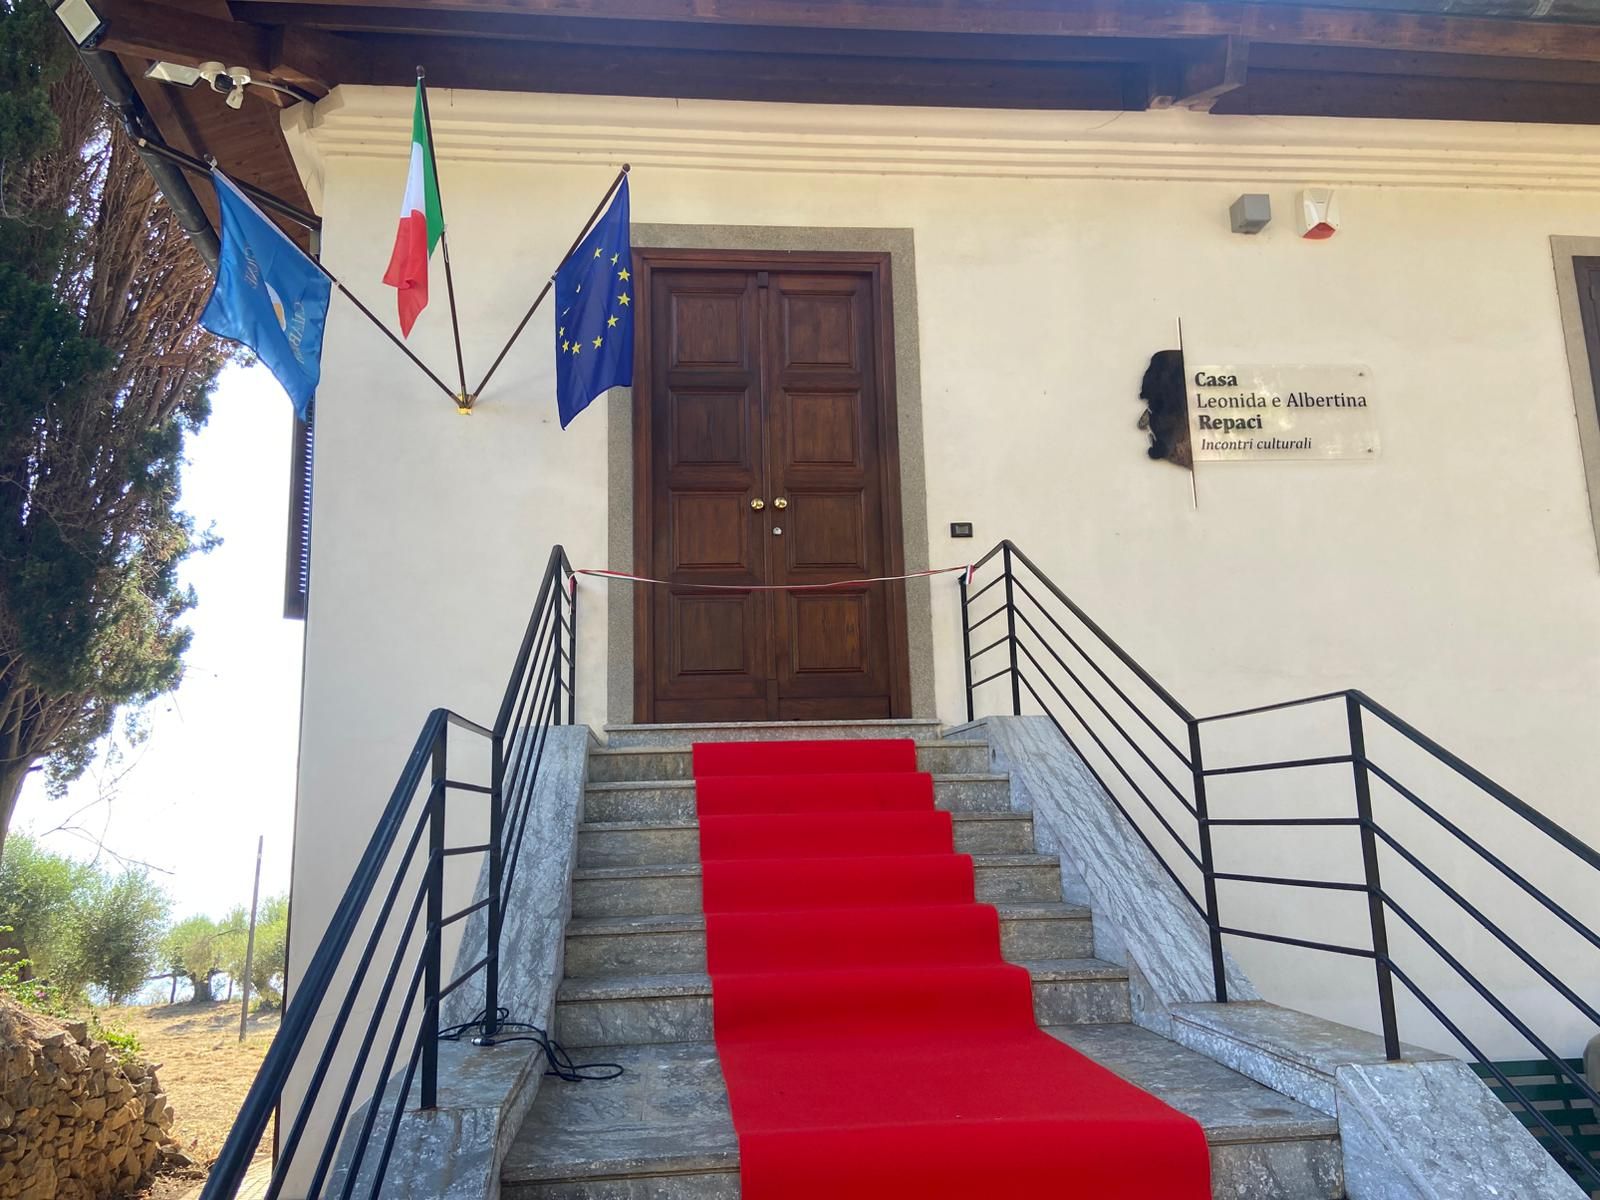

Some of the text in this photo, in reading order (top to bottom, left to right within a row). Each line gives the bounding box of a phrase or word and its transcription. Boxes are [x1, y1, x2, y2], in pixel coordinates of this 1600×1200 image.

[1194, 371, 1238, 387] Casa
[1197, 392, 1367, 408] Leonida e Albertina
[1198, 414, 1263, 433] Repaci
[1201, 438, 1312, 450] Incontri culturali
